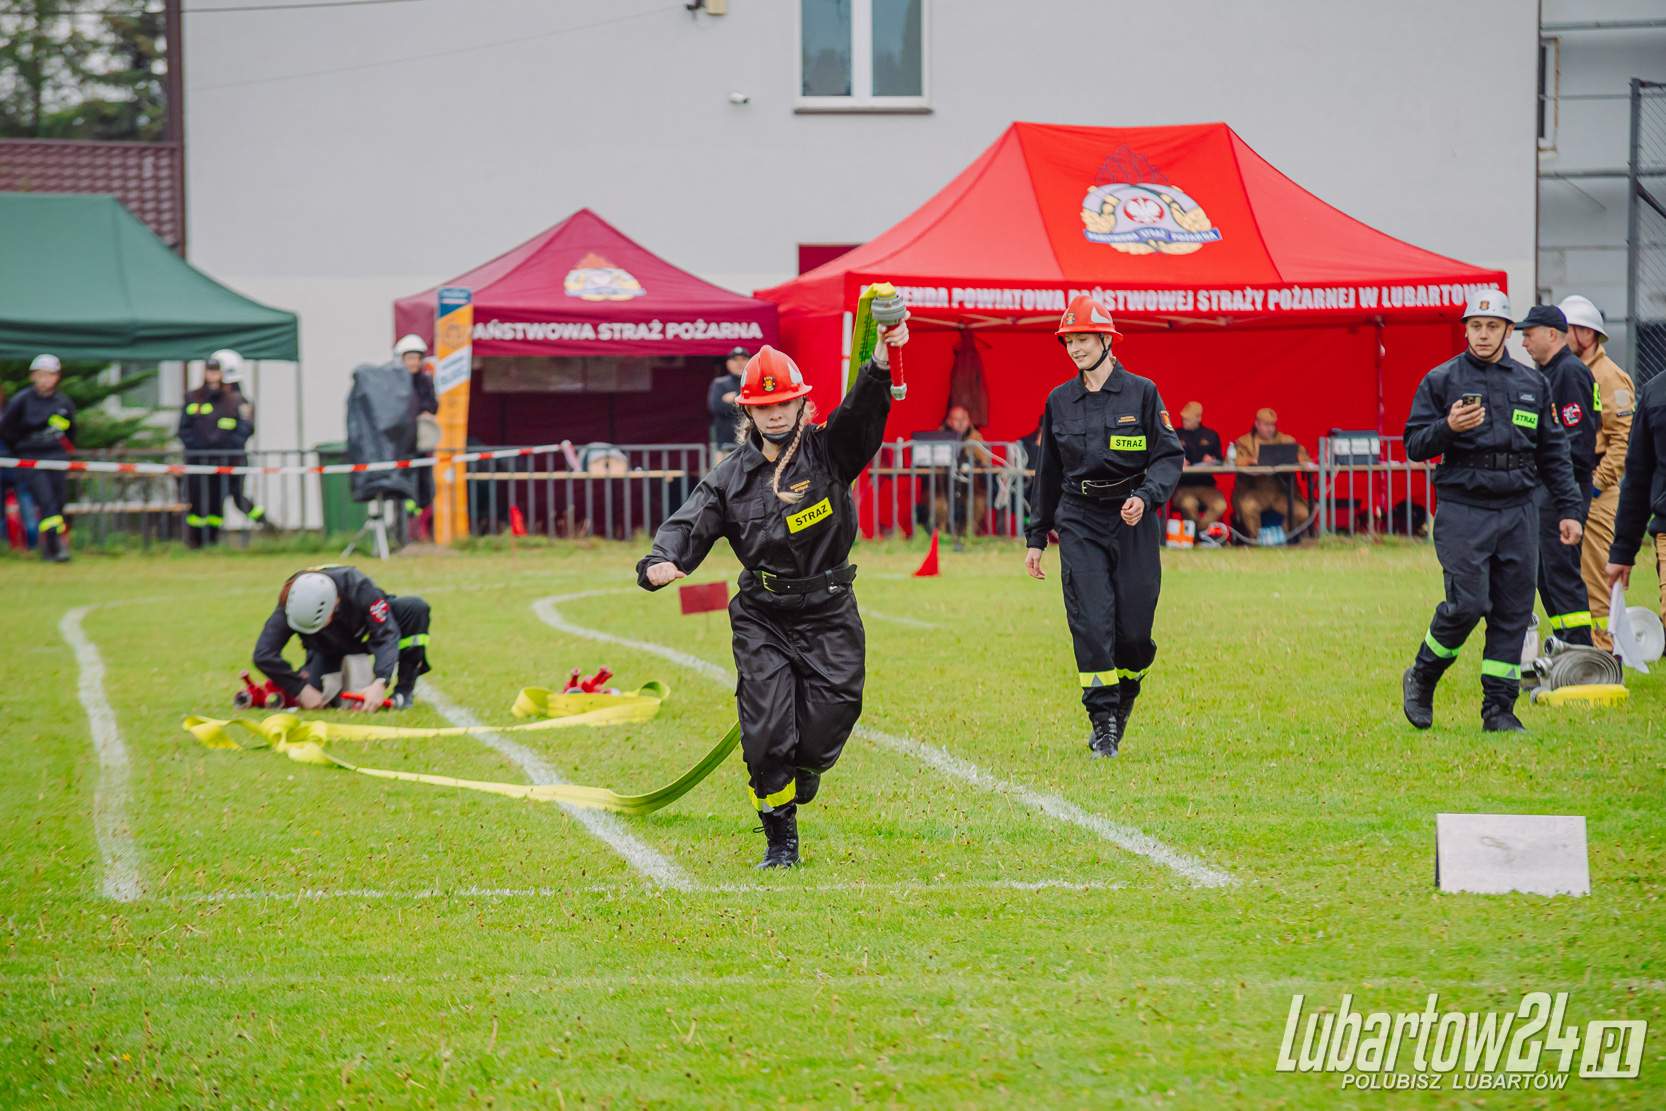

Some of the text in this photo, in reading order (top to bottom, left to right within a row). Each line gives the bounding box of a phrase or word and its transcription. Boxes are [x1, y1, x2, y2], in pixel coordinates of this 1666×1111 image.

[951, 286, 1066, 311] POWIATOWA
[1197, 285, 1265, 312] STRAŻY
[1267, 284, 1356, 311] POŻARNEJ
[1358, 286, 1379, 309] W
[472, 318, 764, 341] AŃSTWOWA STRAŻ POŻARNA
